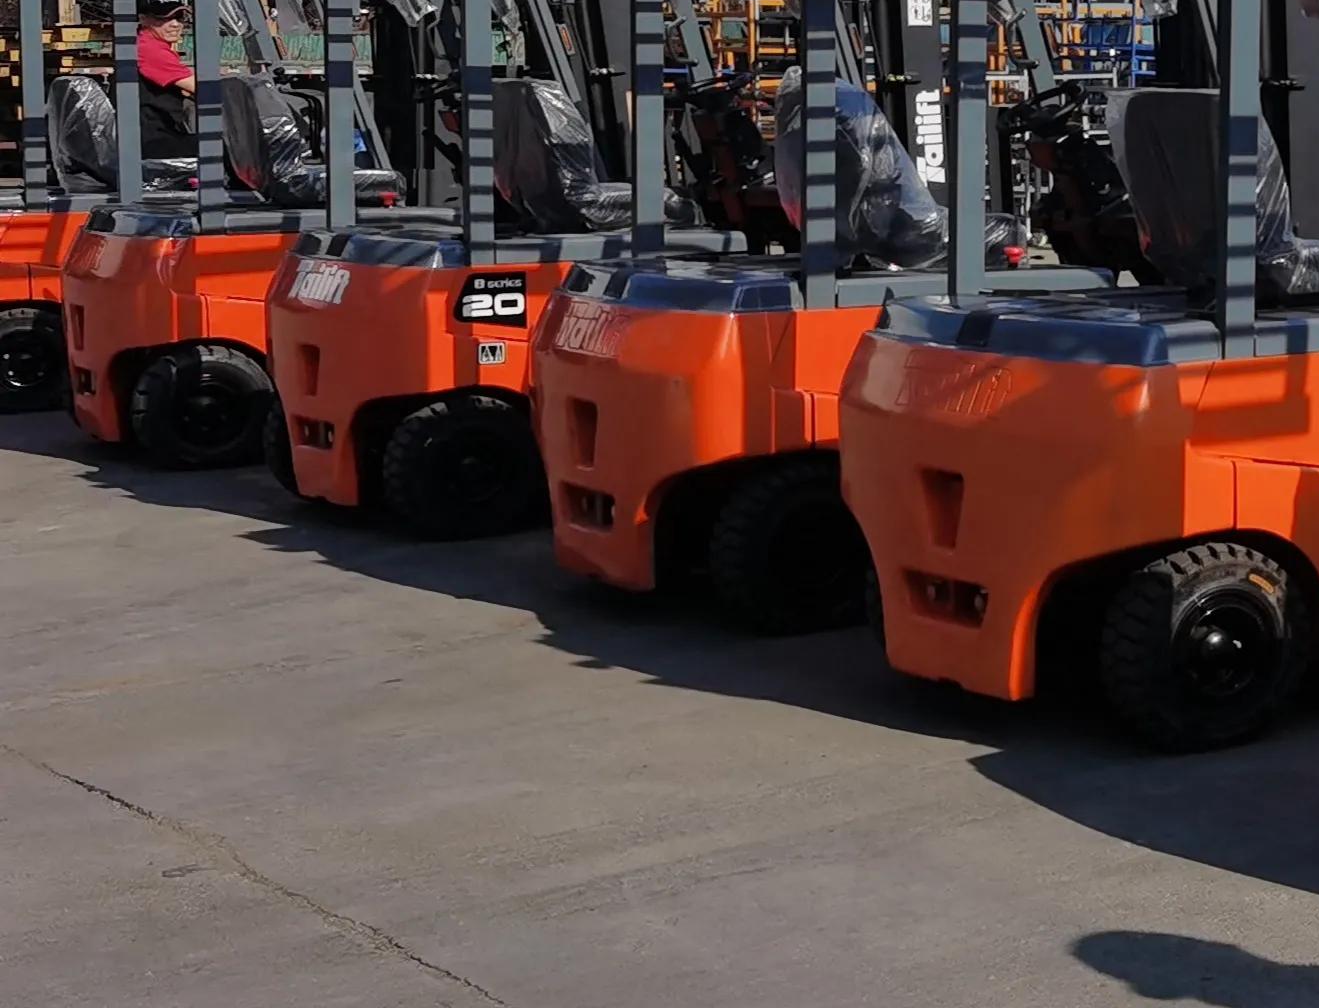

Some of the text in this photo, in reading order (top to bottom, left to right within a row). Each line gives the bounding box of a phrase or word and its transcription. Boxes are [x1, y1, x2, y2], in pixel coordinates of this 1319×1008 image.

[915, 88, 946, 188] Tailift
[288, 259, 351, 305] Tailift
[474, 278, 486, 290] 8
[462, 292, 525, 318] 20
